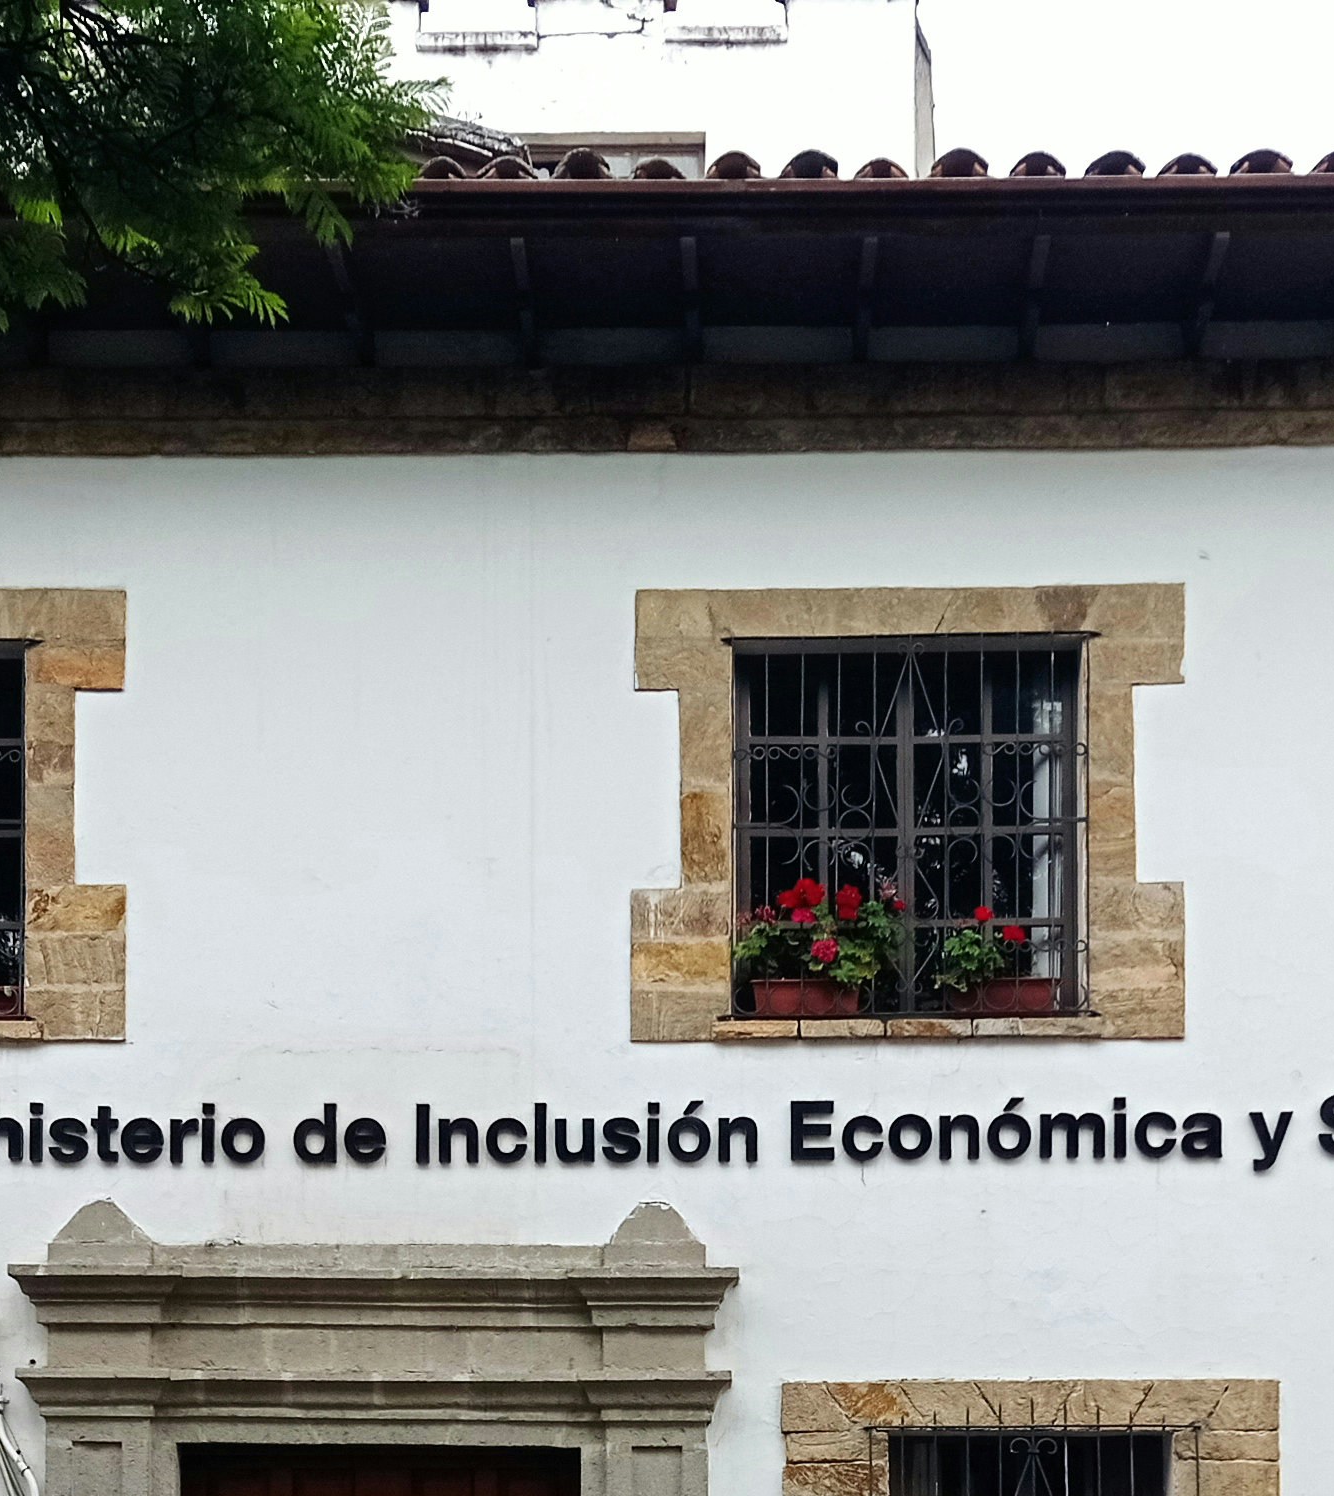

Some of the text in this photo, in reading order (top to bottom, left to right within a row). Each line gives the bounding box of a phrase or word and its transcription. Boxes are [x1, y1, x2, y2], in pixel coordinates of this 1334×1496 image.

[293, 1102, 387, 1168] de
[415, 1100, 758, 1167] Inclusión
[790, 1096, 1223, 1165] Económica
[1248, 1111, 1295, 1173] y
